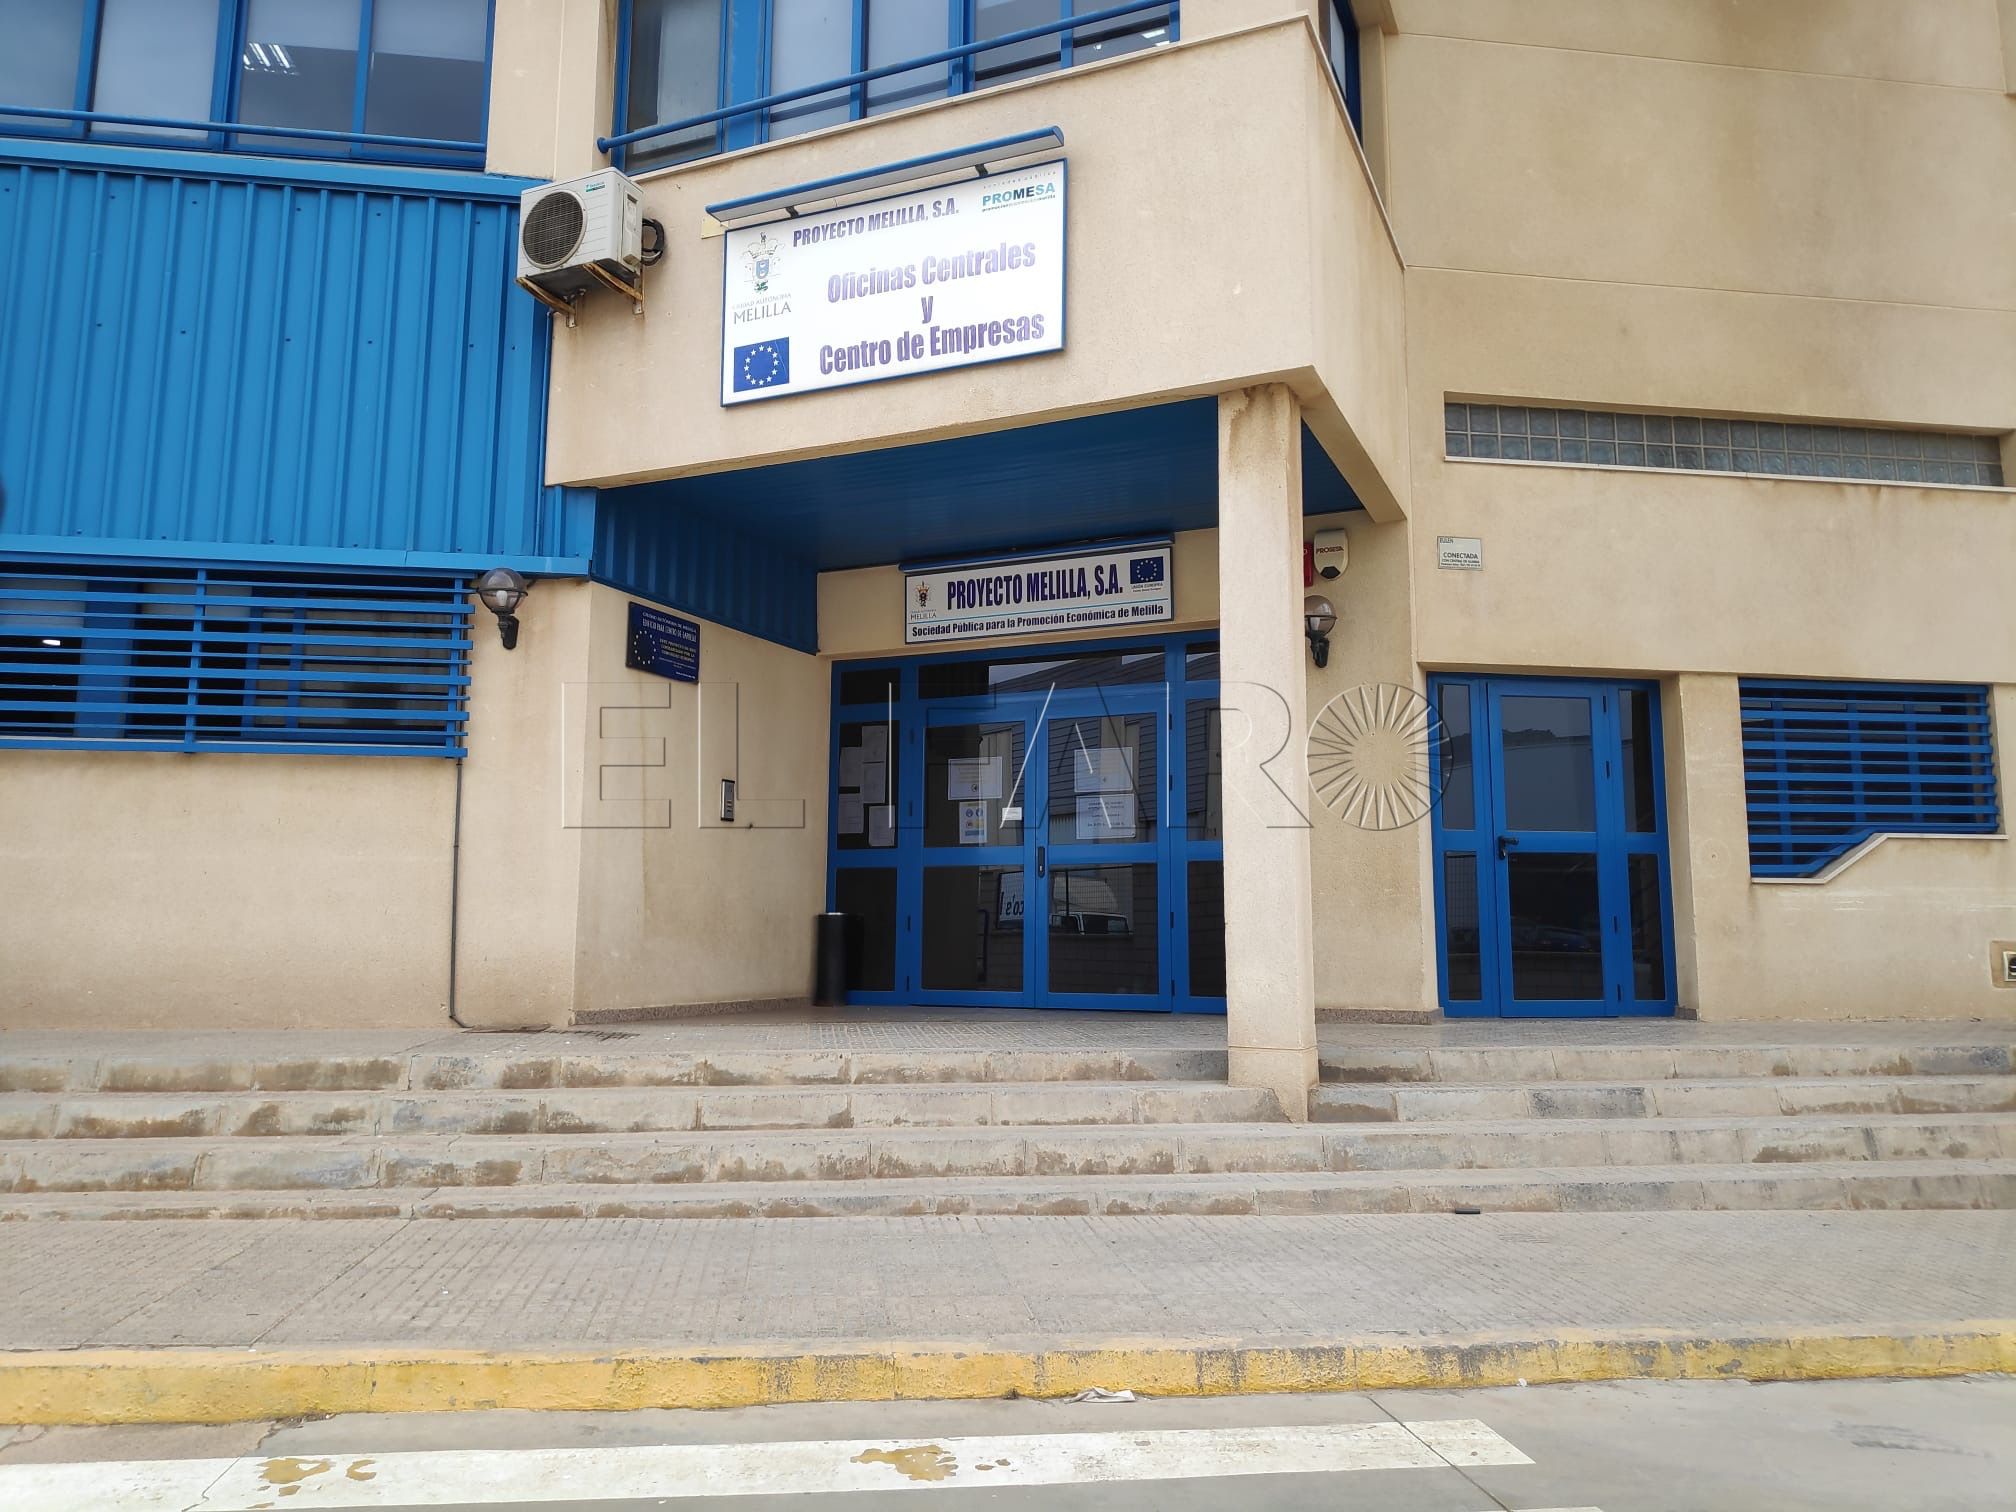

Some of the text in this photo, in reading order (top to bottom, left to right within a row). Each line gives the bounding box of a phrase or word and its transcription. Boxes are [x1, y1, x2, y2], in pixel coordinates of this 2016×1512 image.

[982, 182, 1056, 206] PROMESA
[793, 217, 865, 248] PROYECTO
[867, 207, 930, 232] MELILLA,
[932, 198, 960, 217] S.A.
[827, 242, 1036, 303] Oficinas Centrales
[733, 301, 792, 325] MELILLA
[920, 296, 934, 324] y
[819, 313, 1045, 375] Centro de Empresas
[1443, 551, 1479, 559] CONECTADA
[947, 564, 1124, 611] PROYECTO MELILLA, S.A.
[912, 604, 1164, 637] Sociedad Pública para la Promoción Económica de Melilla
